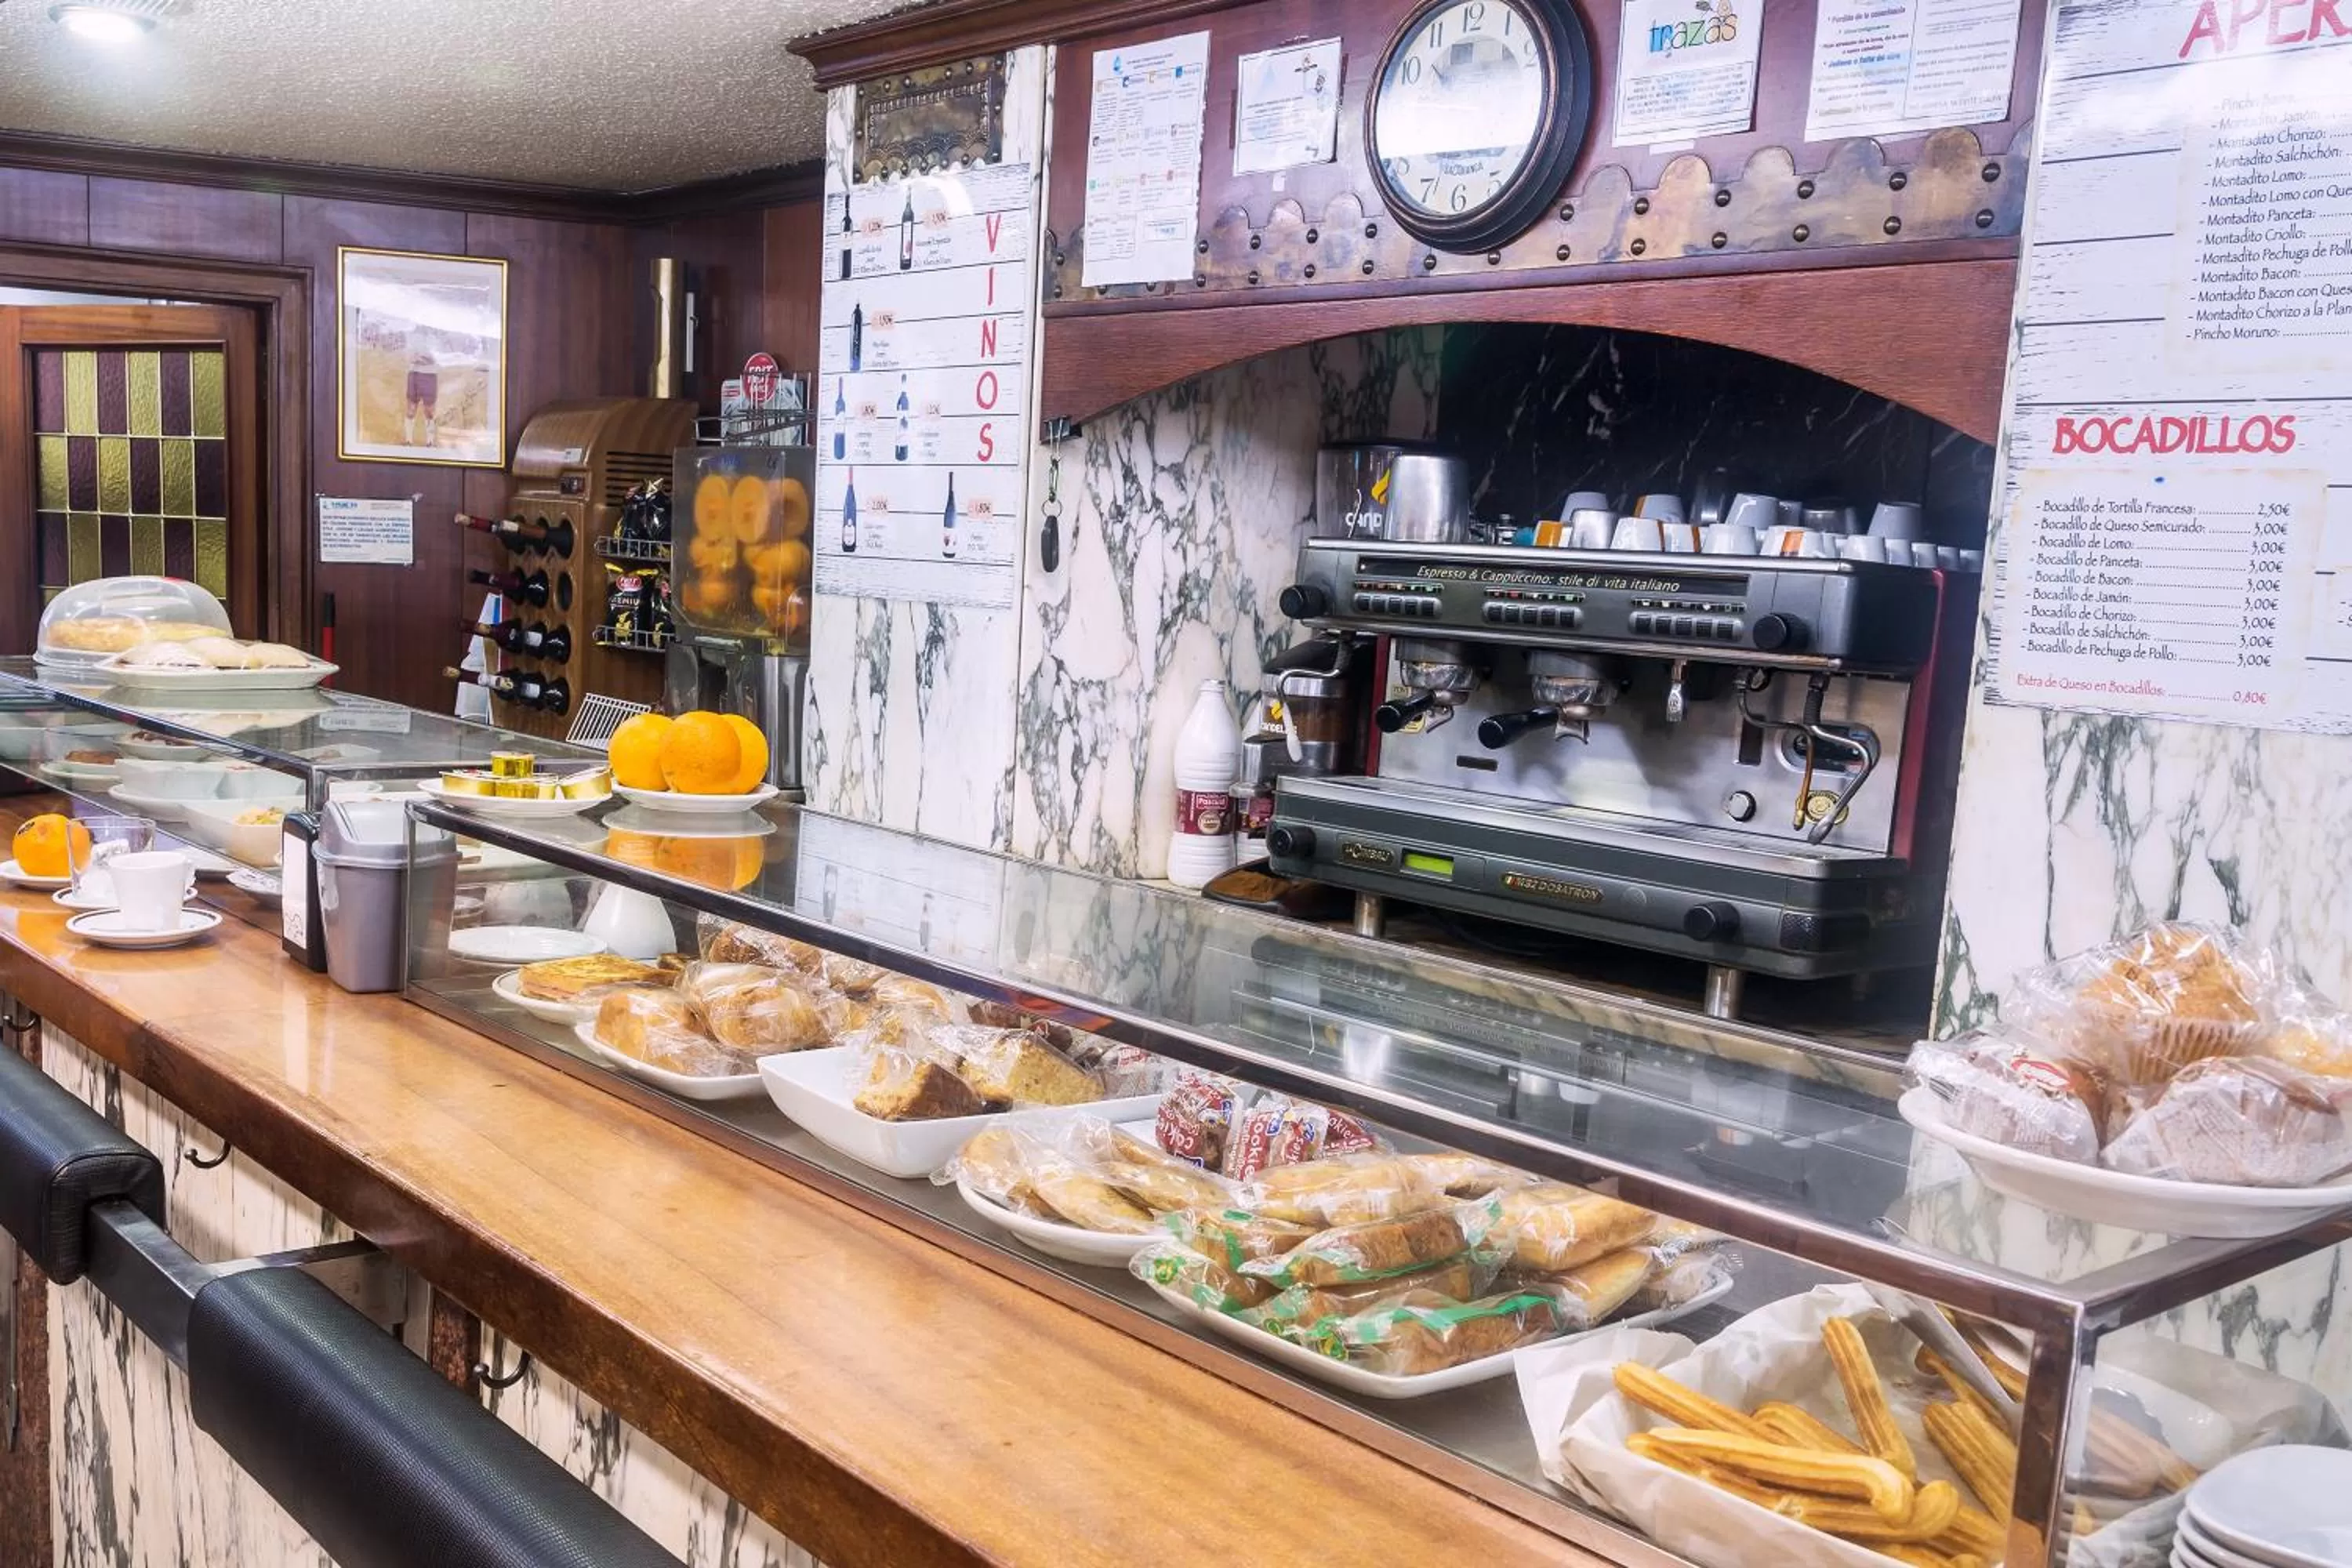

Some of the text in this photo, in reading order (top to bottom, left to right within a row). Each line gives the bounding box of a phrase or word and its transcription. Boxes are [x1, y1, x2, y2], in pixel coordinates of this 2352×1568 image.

[1463, 3, 1484, 33] 12
[1504, 9, 1511, 36] 1
[1429, 22, 1443, 48] 11
[1648, 13, 1737, 53] trazas
[1402, 56, 1421, 85] 10
[2217, 128, 2326, 149] Montadito Chorizo:
[2215, 149, 2272, 168] Montadito
[2212, 168, 2307, 187] Montadito Lomo:
[1420, 178, 1435, 203] 7
[1451, 183, 1467, 212] 6
[2209, 188, 2266, 207] Montadito
[2269, 190, 2300, 202] Lomo
[2303, 189, 2325, 200] con
[2207, 207, 2316, 226] Montadito Panceta:
[2205, 223, 2305, 245] Montadito Criollo:
[2202, 245, 2259, 264] Montadito
[2263, 243, 2309, 264] Pechuga
[2312, 241, 2327, 257] de
[2201, 264, 2301, 283] Montadito Bacon:
[2198, 285, 2255, 303] Montadito
[2258, 286, 2294, 300] Bacon
[2296, 288, 2318, 298] con
[2196, 303, 2253, 321] Montadito
[2256, 302, 2300, 319] Chorizo
[2303, 307, 2310, 318] a
[2313, 299, 2323, 316] la
[2194, 323, 2280, 339] Pincho Moruno:
[2053, 415, 2296, 454] BOCADILLOS
[2042, 496, 2090, 512] Bocadillo
[2091, 497, 2105, 513] de
[2107, 499, 2143, 514] Tortilla
[2041, 514, 2088, 530] Bocadillo
[2089, 516, 2103, 531] de
[2104, 520, 2139, 532] Queso
[2038, 533, 2085, 548] Bocadillo
[2087, 534, 2101, 549] de
[2036, 550, 2083, 565] Bocadillo
[2084, 552, 2098, 566] de
[1416, 565, 1681, 593] Espresso & Cappuccino: stile di vita italiano
[2034, 568, 2082, 583] Bocadillo
[2082, 570, 2096, 584] de
[2032, 586, 2078, 601] Bocadillo
[2080, 587, 2094, 602] de
[2031, 604, 2077, 619] Bocadillo
[2078, 604, 2092, 619] de
[2029, 621, 2075, 637] Bocadillo
[2077, 622, 2090, 637] de
[2027, 639, 2073, 654] Bocadillo
[2074, 640, 2088, 655] de
[2089, 641, 2132, 662] Pechuga
[2133, 643, 2147, 659] de
[2017, 673, 2042, 688] Extra
[2044, 673, 2057, 688] de
[2059, 677, 2092, 692] Queso
[2094, 682, 2107, 692] en
[1244, 1113, 1268, 1178] cookie
